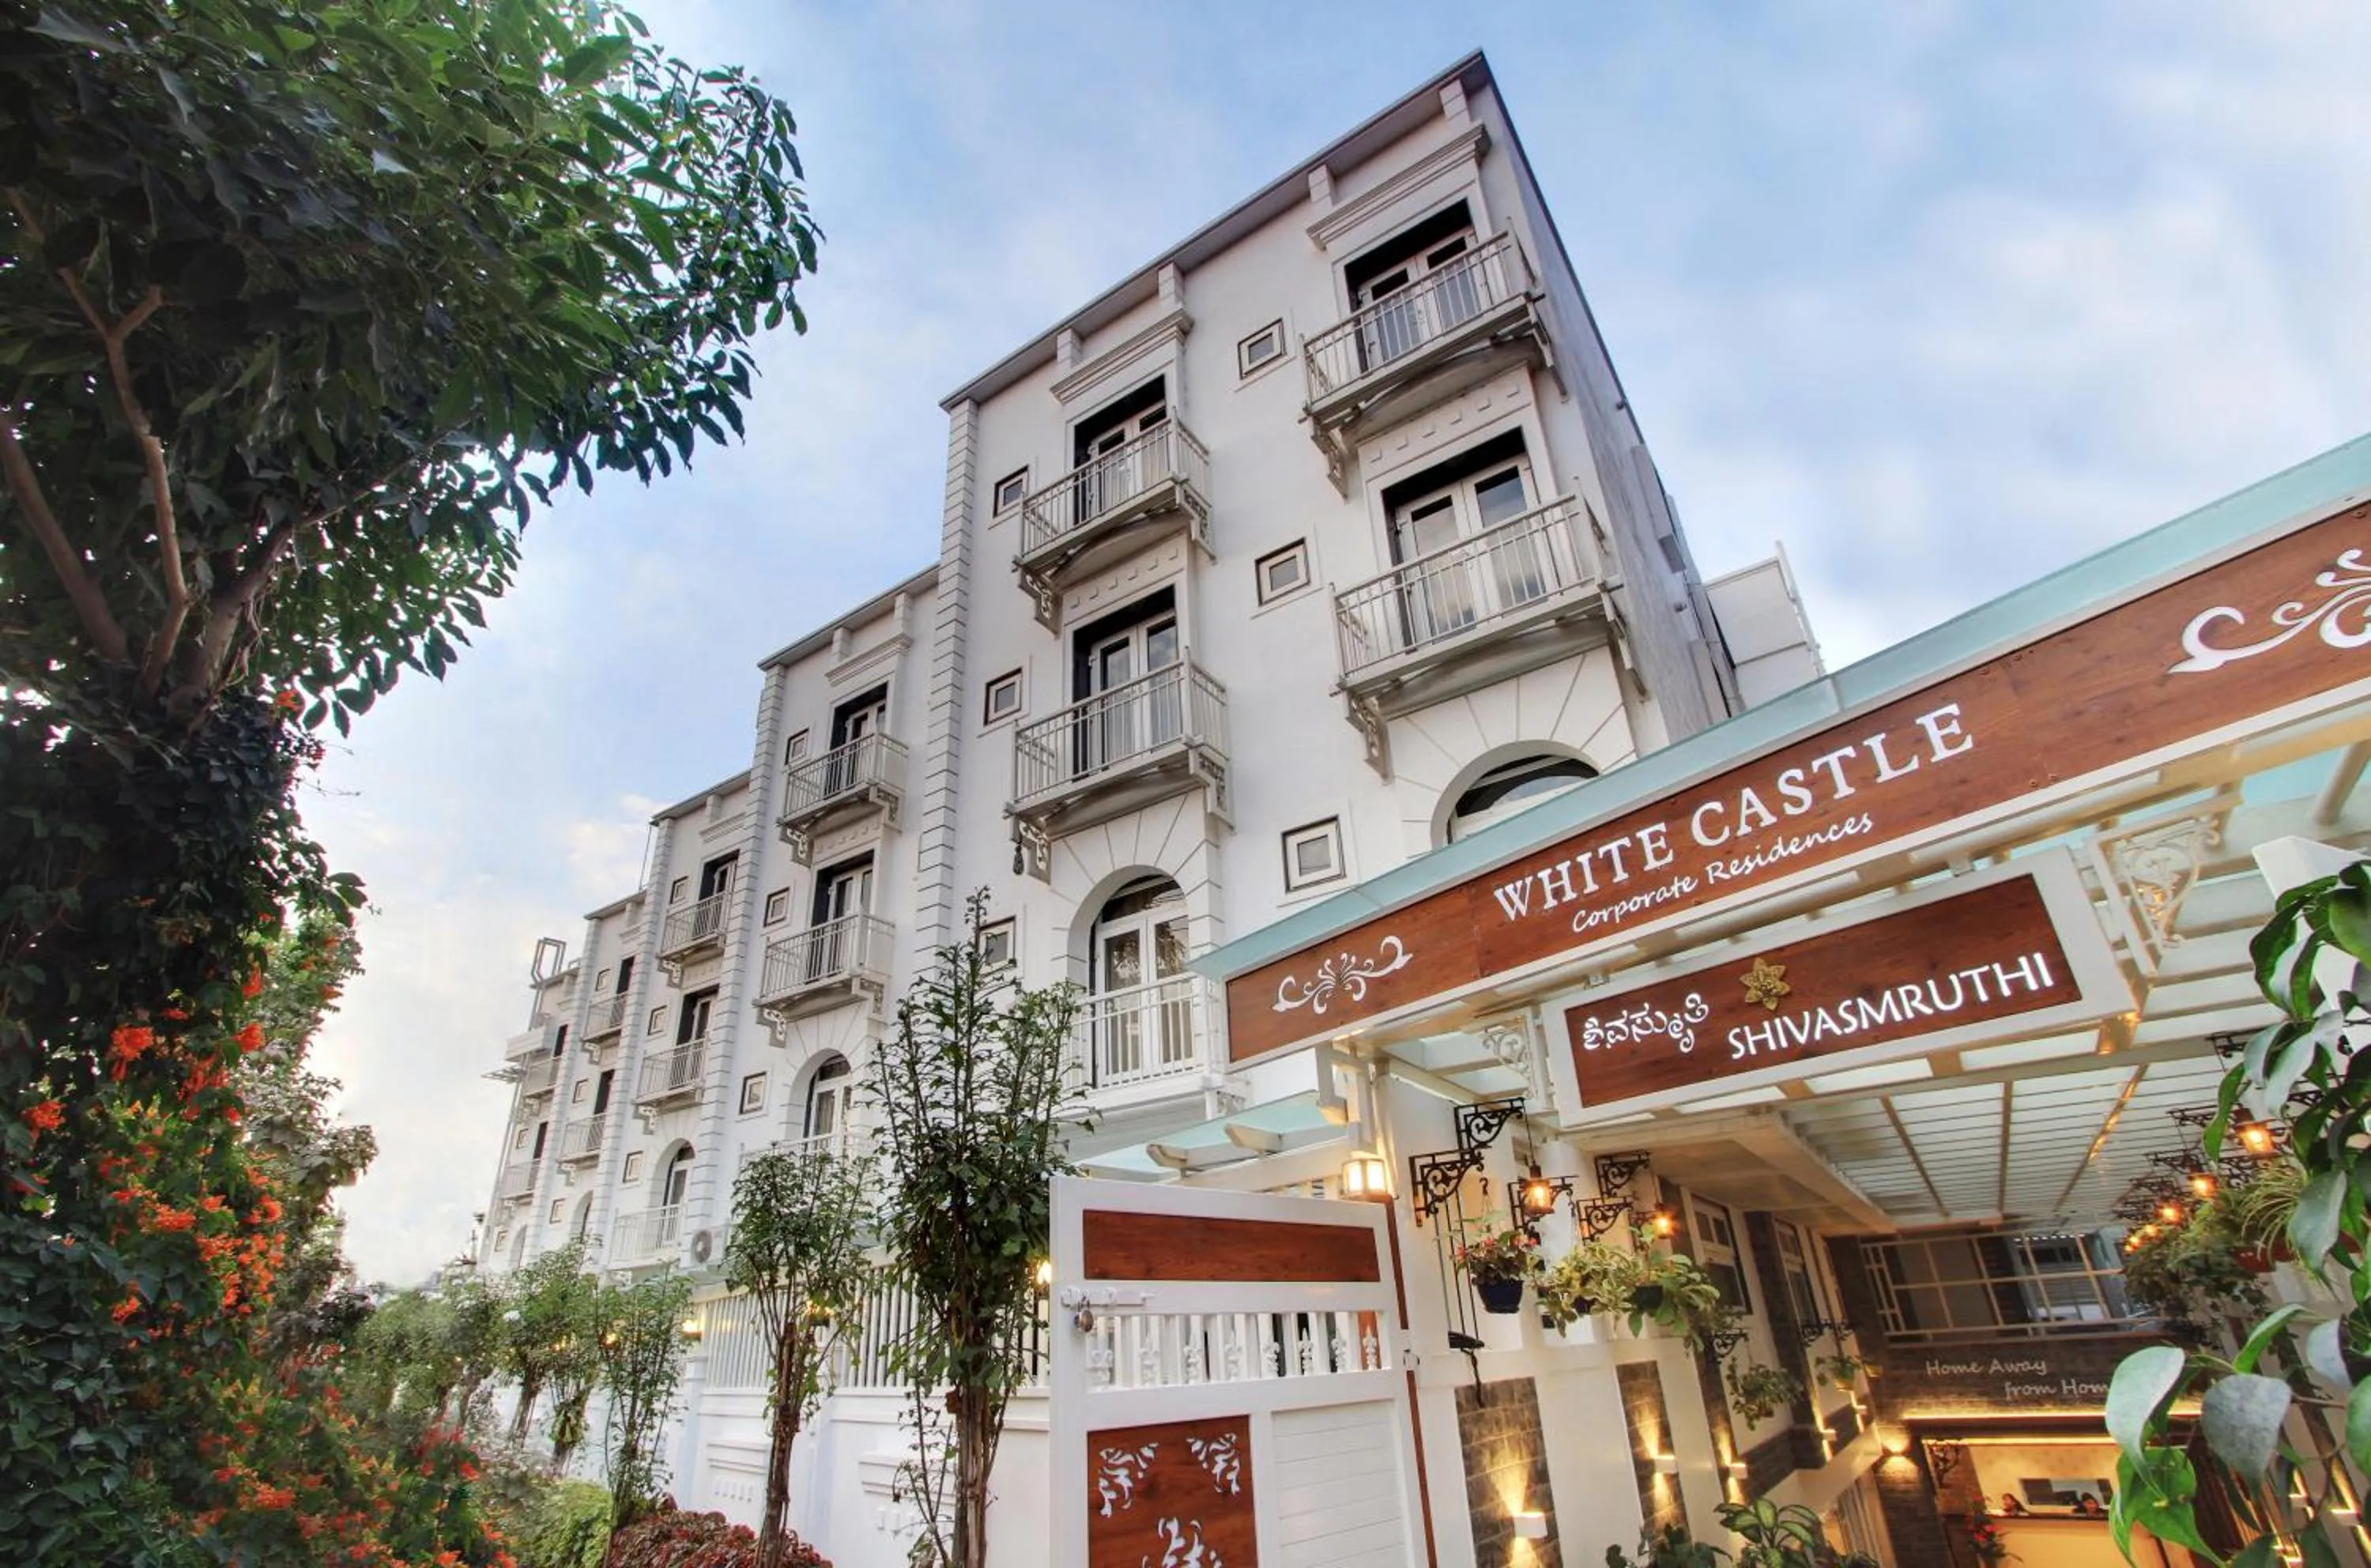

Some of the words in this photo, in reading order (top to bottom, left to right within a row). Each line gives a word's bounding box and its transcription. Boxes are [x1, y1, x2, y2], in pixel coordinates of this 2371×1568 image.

[1494, 823, 1675, 922] WHITE
[1691, 703, 1974, 847] CASTLE
[1572, 874, 1698, 933] Corporate
[1706, 812, 1874, 883] Residences
[1728, 952, 2055, 1060] SHIVASMRUTHI
[1925, 1359, 1984, 1377] Home
[1988, 1358, 2047, 1376] Away
[2004, 1381, 2056, 1401] from
[2060, 1378, 2109, 1398] Hom
